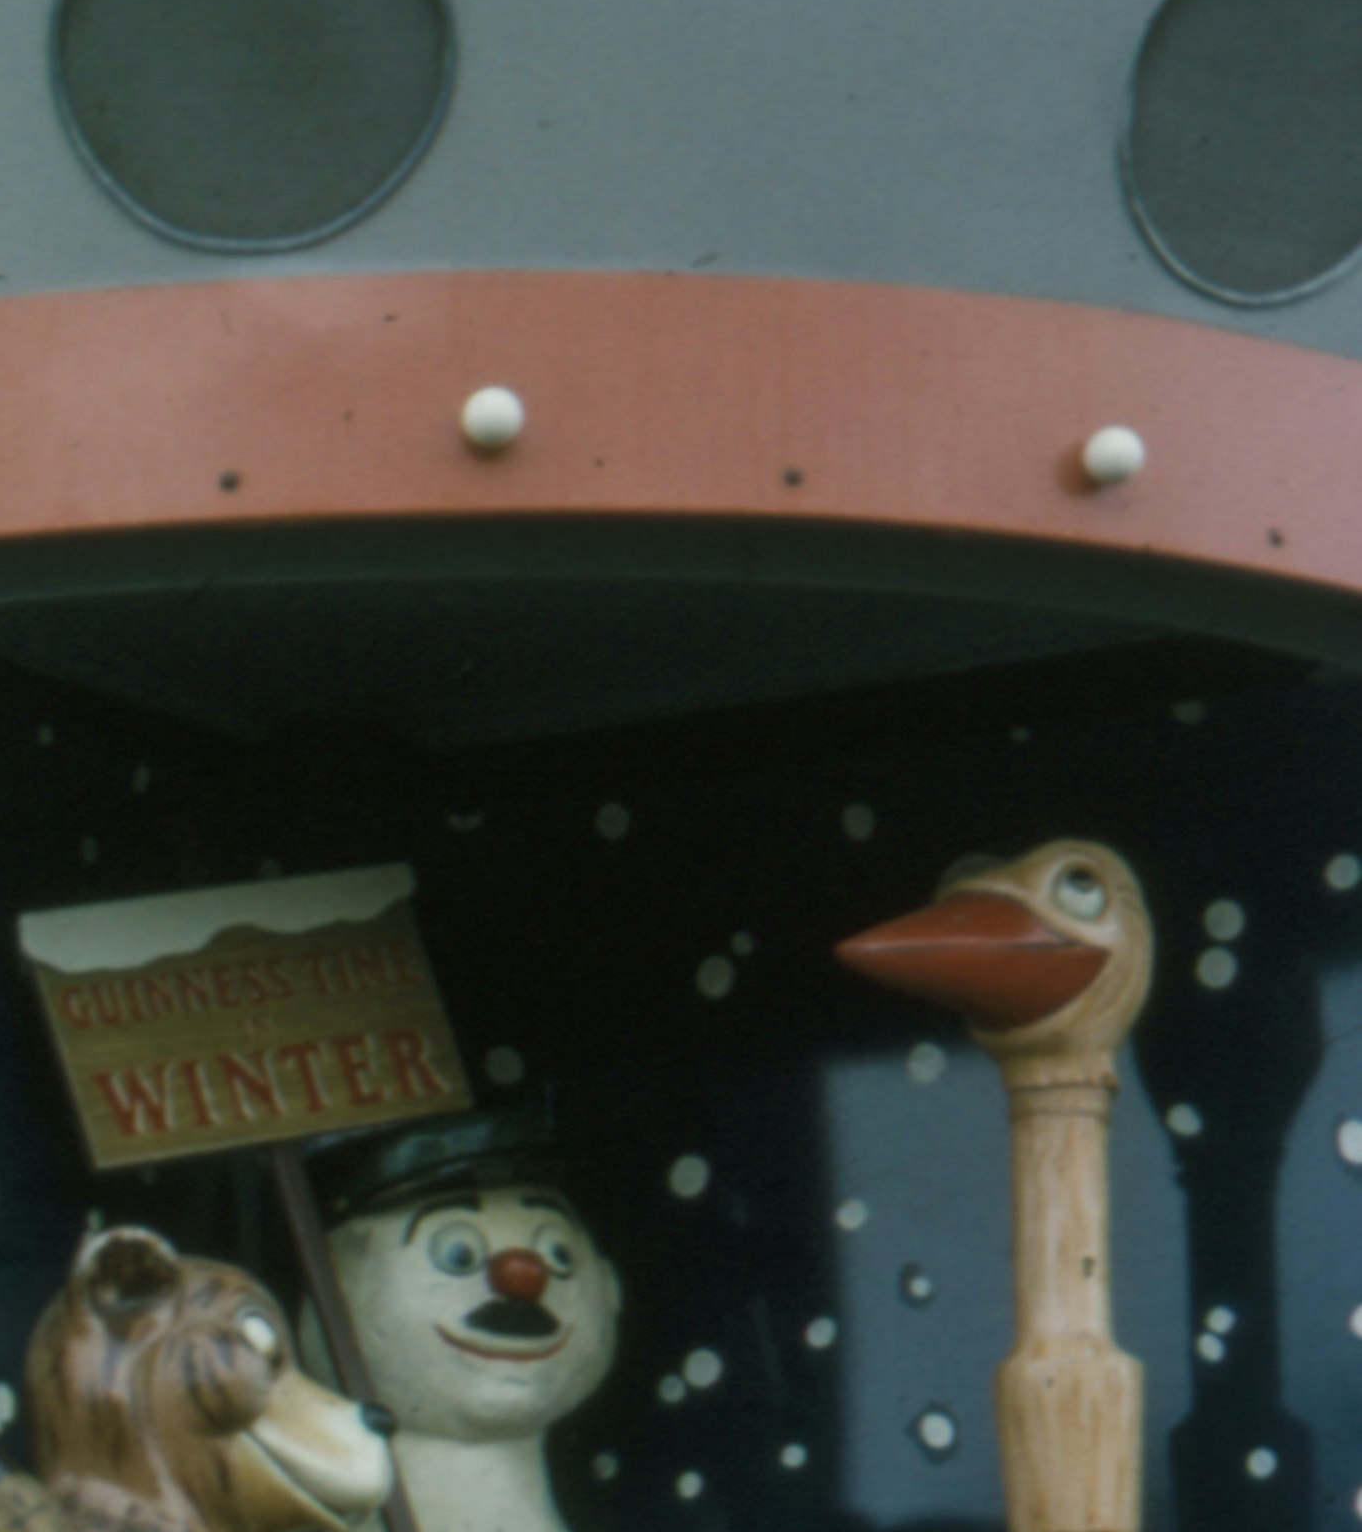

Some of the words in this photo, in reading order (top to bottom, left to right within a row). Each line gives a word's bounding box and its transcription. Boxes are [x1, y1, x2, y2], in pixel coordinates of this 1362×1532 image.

[63, 957, 295, 1029] GUINNESS
[301, 940, 422, 996] TIME
[93, 1028, 449, 1137] WINTER
